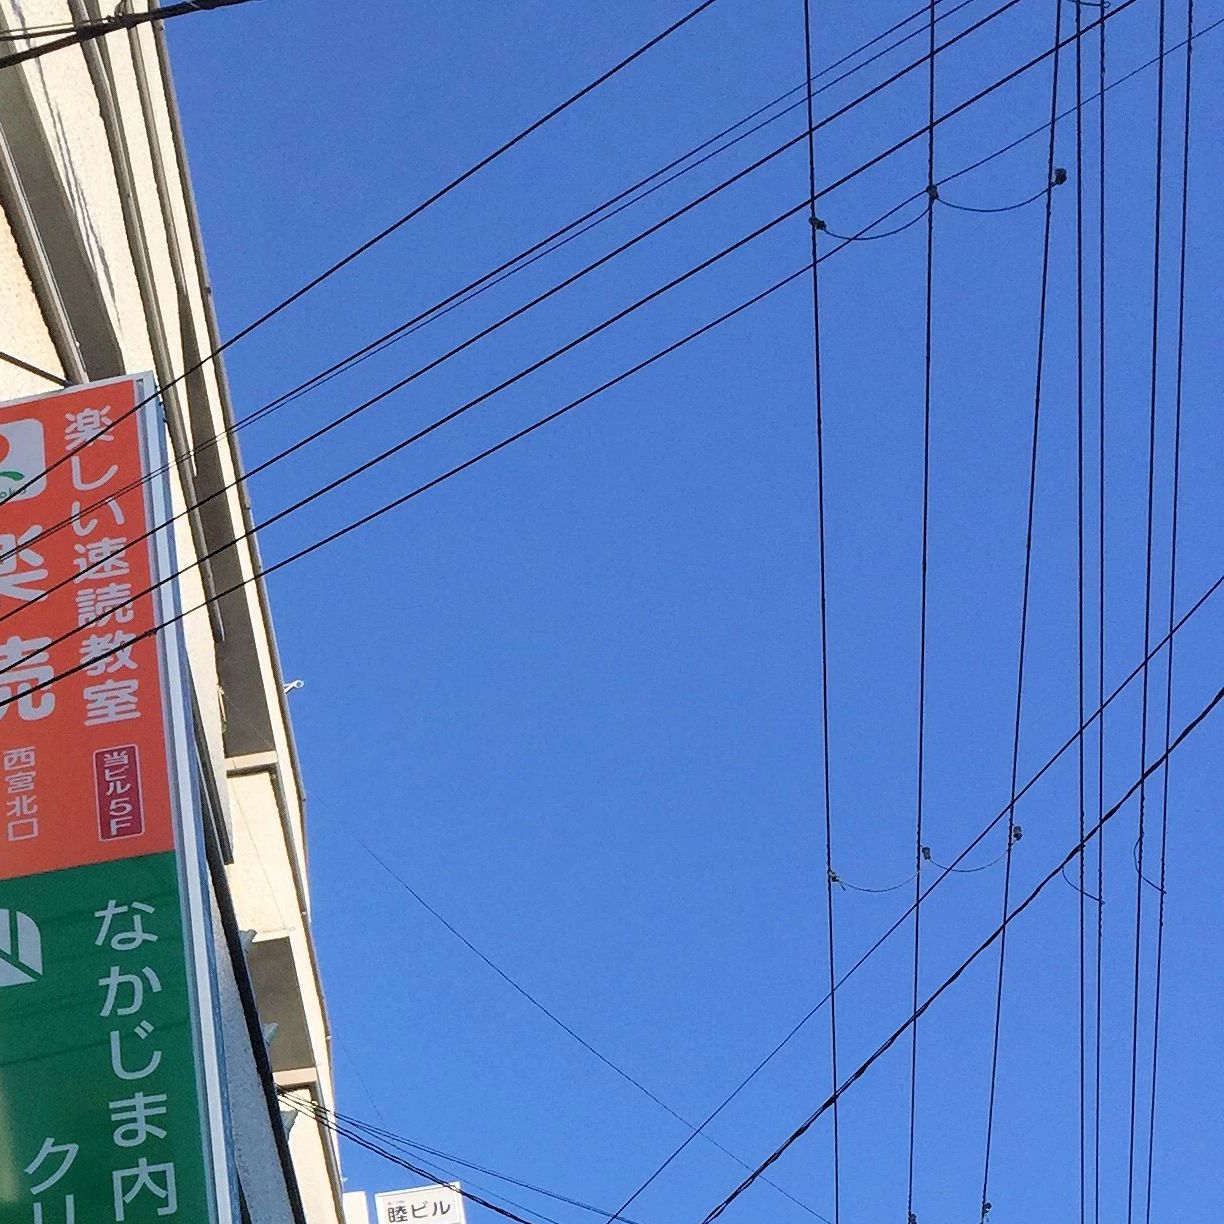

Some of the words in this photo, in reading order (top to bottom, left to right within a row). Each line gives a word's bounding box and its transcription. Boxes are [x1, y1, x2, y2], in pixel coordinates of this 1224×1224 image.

[64, 404, 143, 727] 楽しい速読教室
[1, 745, 40, 841] 西宮北口
[102, 749, 134, 835] 当ビル5F
[387, 1200, 451, 1223] 睦ビル
